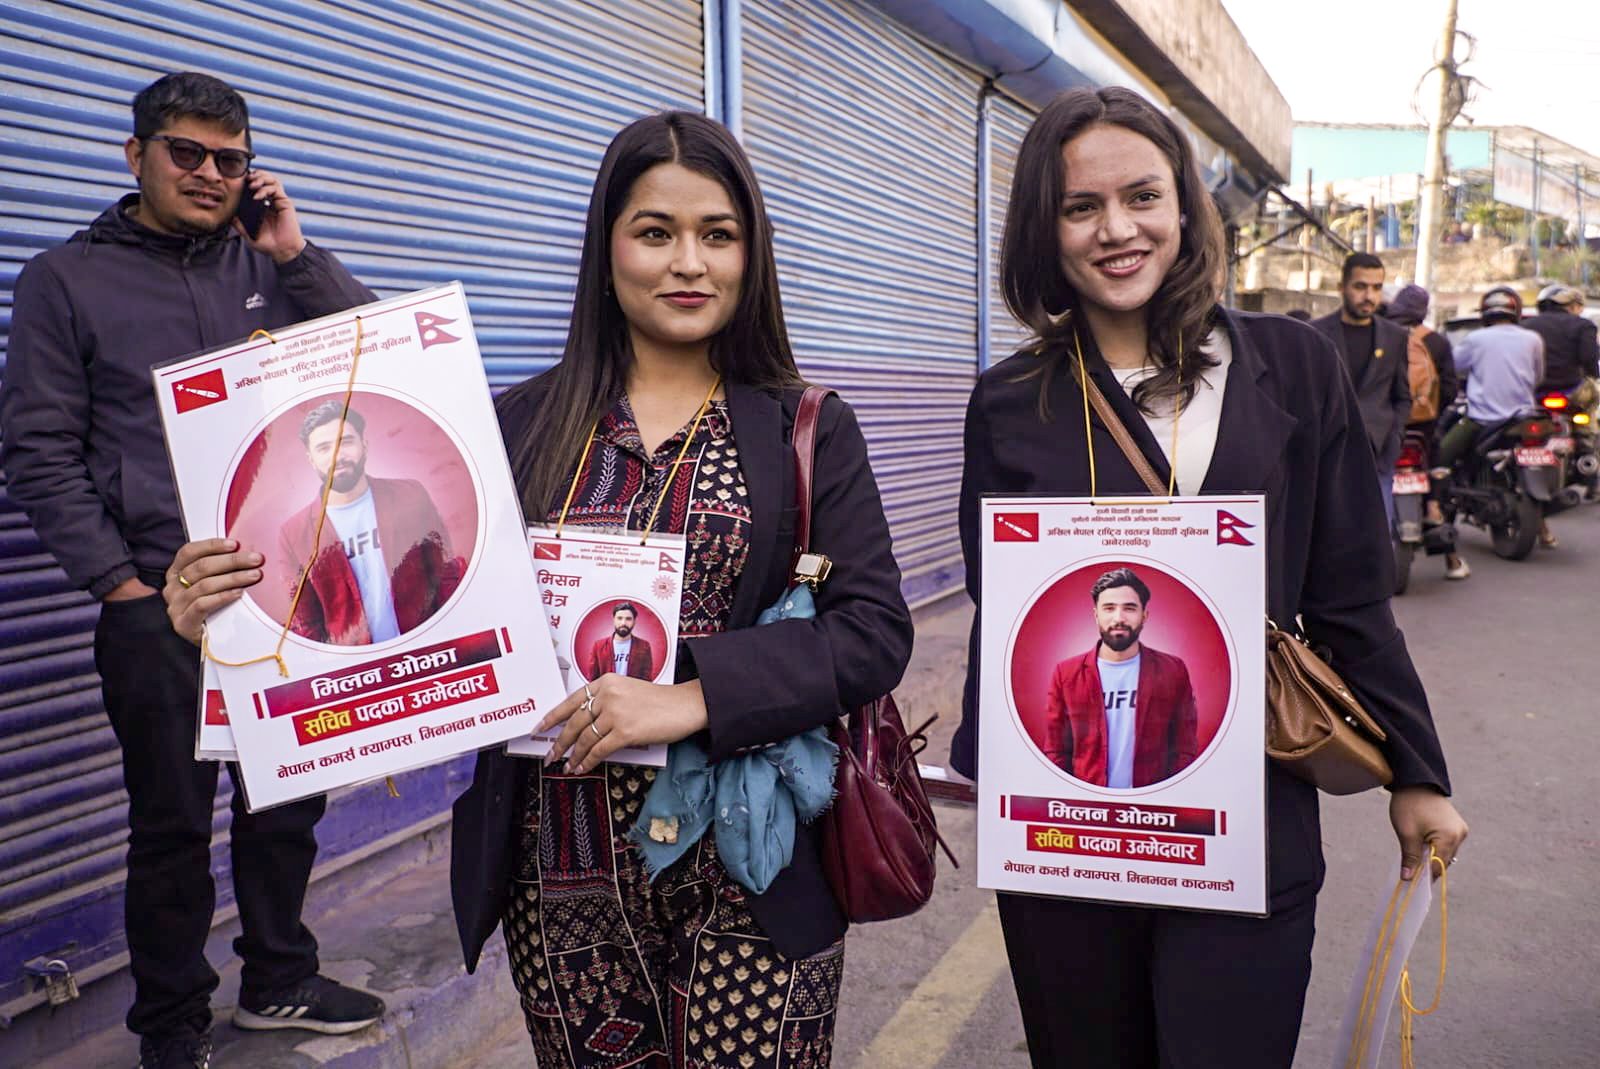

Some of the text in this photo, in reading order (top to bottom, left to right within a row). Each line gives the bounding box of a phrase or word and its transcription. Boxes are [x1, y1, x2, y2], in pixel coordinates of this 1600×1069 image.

[234, 375, 262, 389] अखिल
[264, 368, 288, 380] नेपाल
[1047, 527, 1071, 536] अखिल
[1073, 527, 1094, 536] नेपाल
[537, 569, 582, 587] मिसन
[541, 589, 568, 607] चैत्र
[310, 648, 456, 699] मिलन ओझा
[303, 673, 488, 736] सचिव पदका उम्मेदवार
[276, 760, 316, 778] नेपाल
[319, 747, 356, 767] कमर्स
[419, 717, 476, 740] मिनभवन
[1048, 800, 1177, 827] मिलन ओझा
[1034, 828, 1198, 860] सचिव पदका उम्मेदवार
[1004, 860, 1035, 874] नेपाल
[1039, 865, 1069, 878] कमर्स
[1127, 870, 1177, 886] मिनभवन
